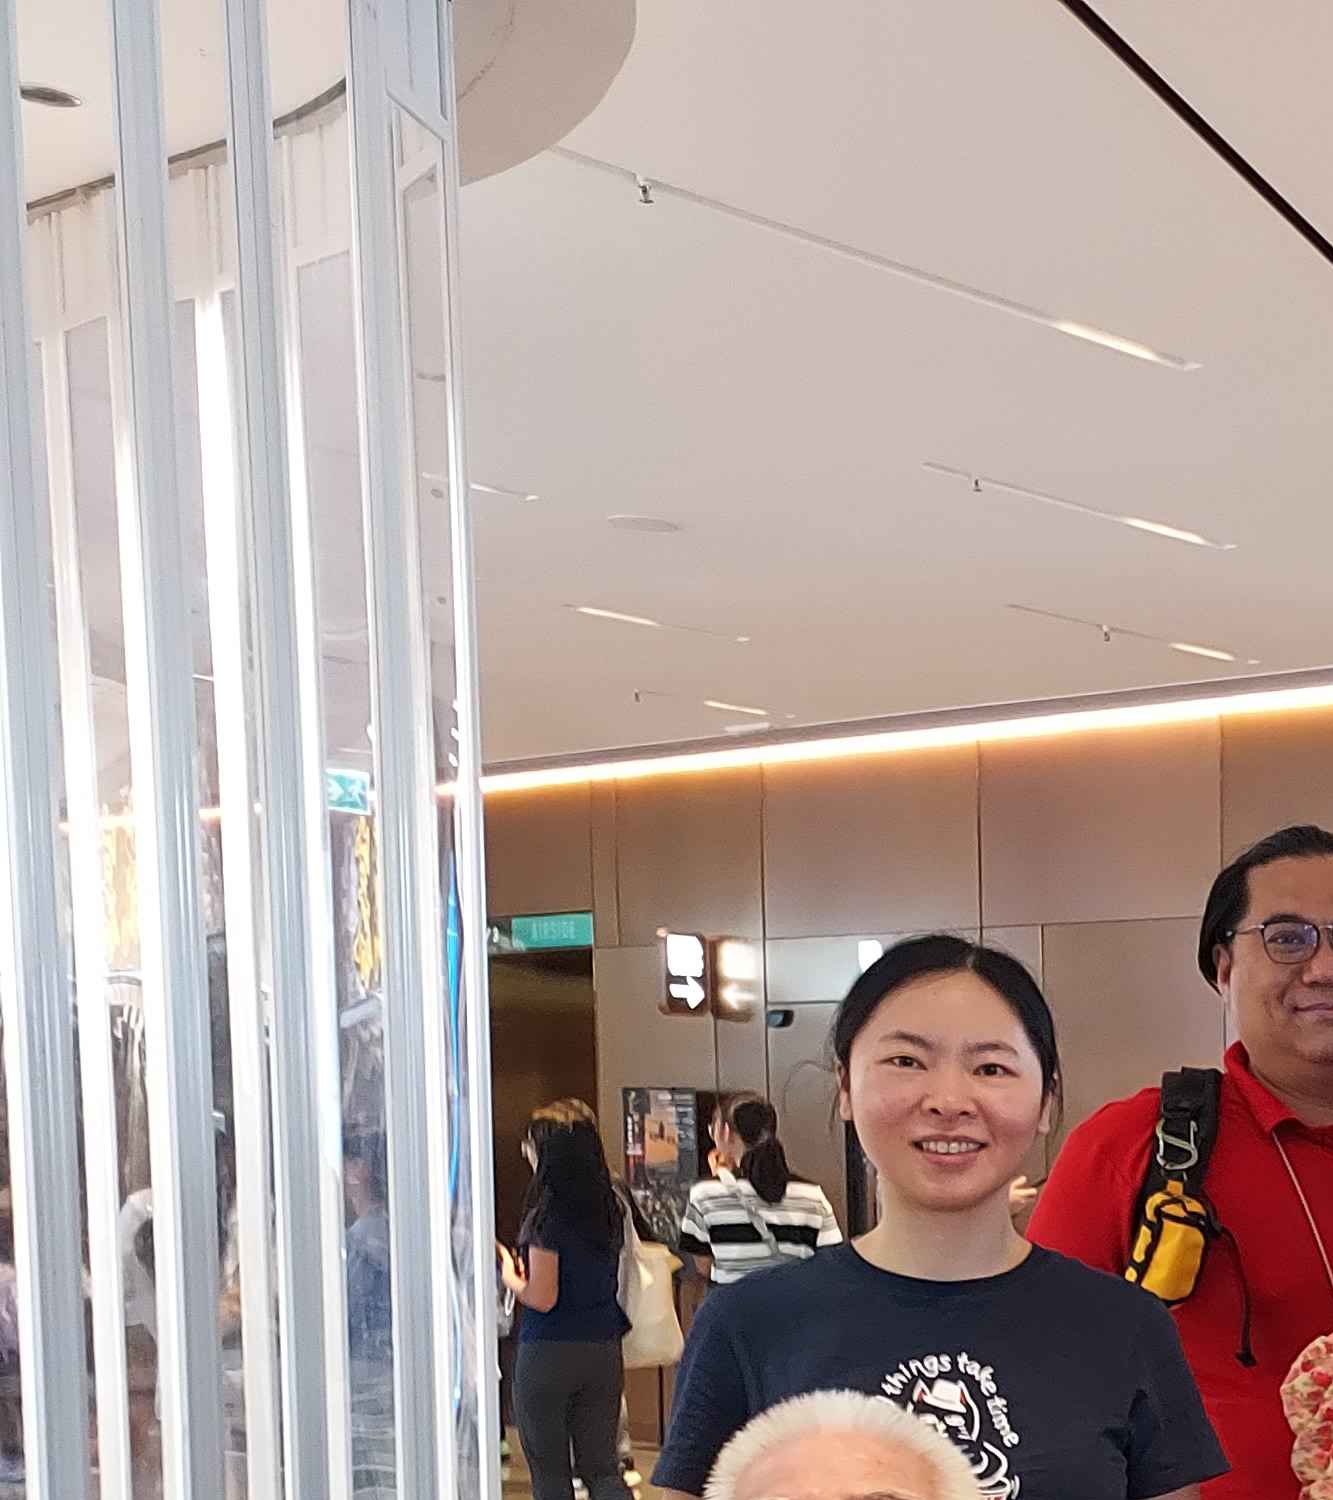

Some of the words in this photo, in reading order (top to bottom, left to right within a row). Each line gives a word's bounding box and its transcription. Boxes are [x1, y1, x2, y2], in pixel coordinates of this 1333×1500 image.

[881, 1353, 952, 1396] things
[957, 1351, 998, 1397] take
[985, 1394, 1020, 1448] time
